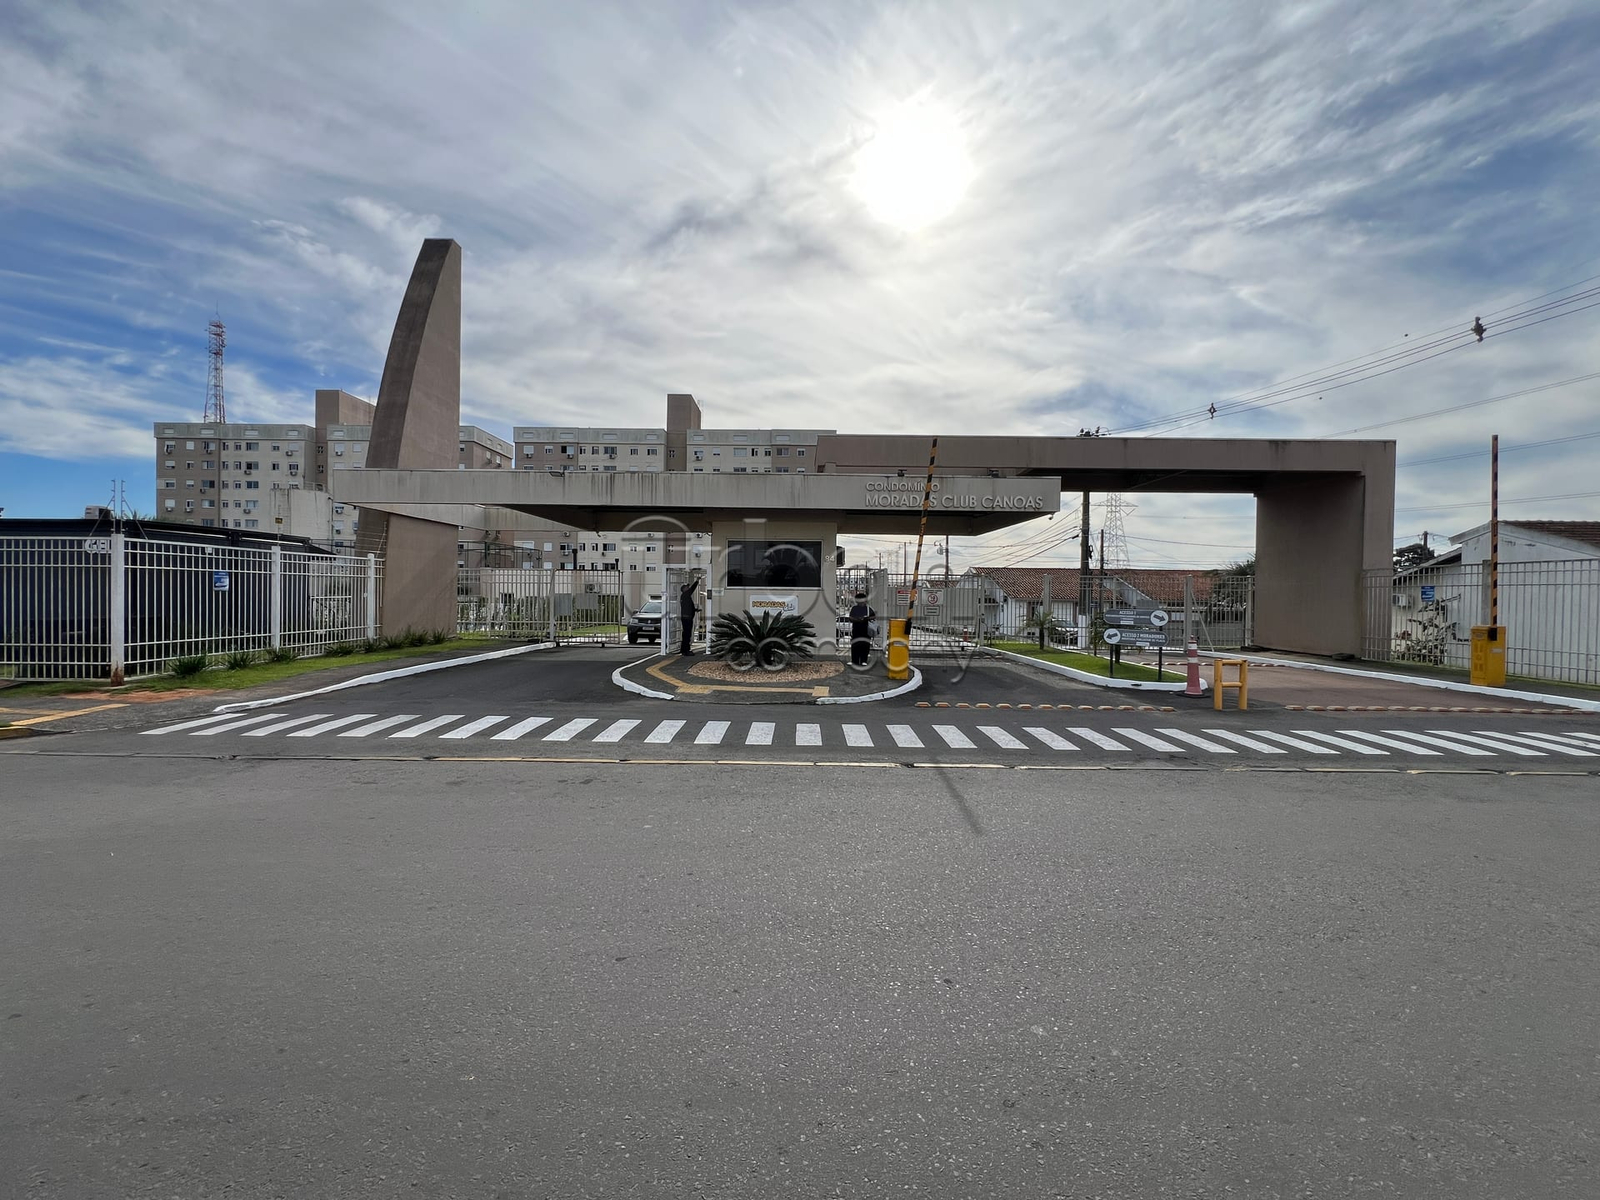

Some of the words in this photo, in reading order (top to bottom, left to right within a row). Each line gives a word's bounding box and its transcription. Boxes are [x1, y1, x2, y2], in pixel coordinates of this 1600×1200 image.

[865, 480, 940, 492] CONDOMÍNO
[941, 495, 977, 509] CLUB
[982, 496, 1043, 510] CANOAS
